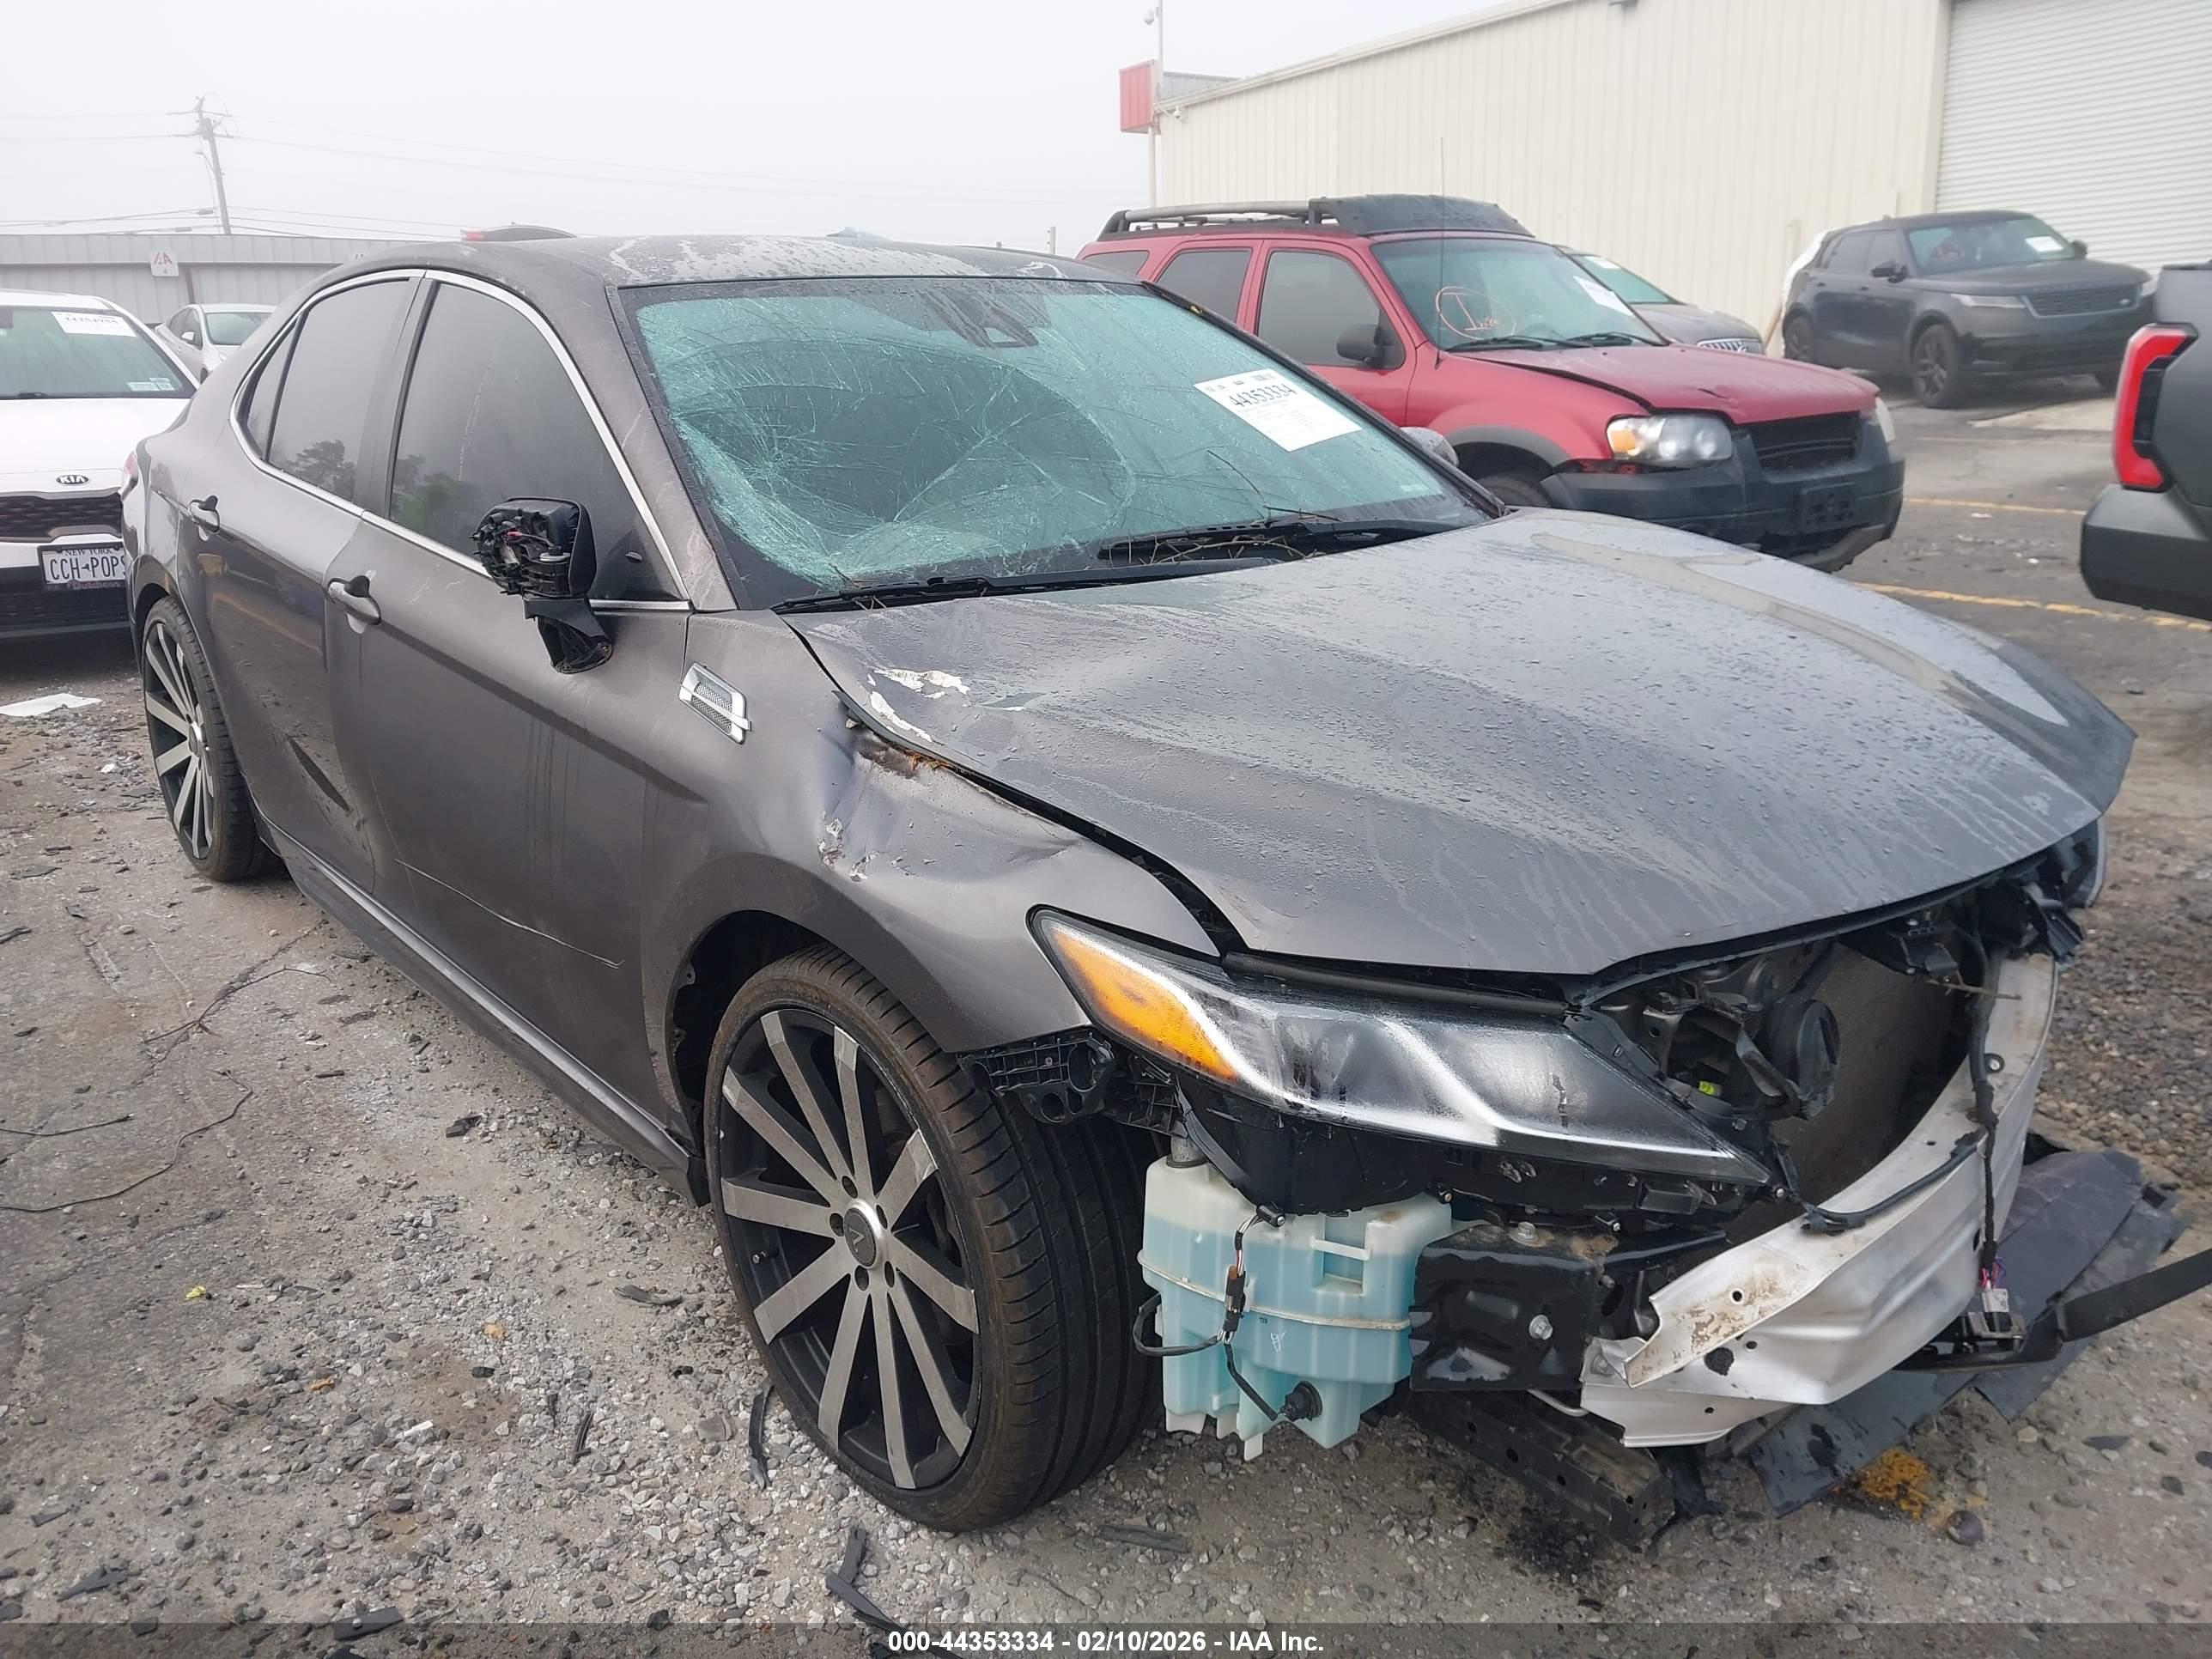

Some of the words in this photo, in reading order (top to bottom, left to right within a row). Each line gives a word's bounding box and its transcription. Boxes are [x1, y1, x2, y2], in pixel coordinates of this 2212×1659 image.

[1228, 383, 1298, 407] 44353334
[60, 474, 86, 483] KIA
[50, 557, 81, 580] CCH
